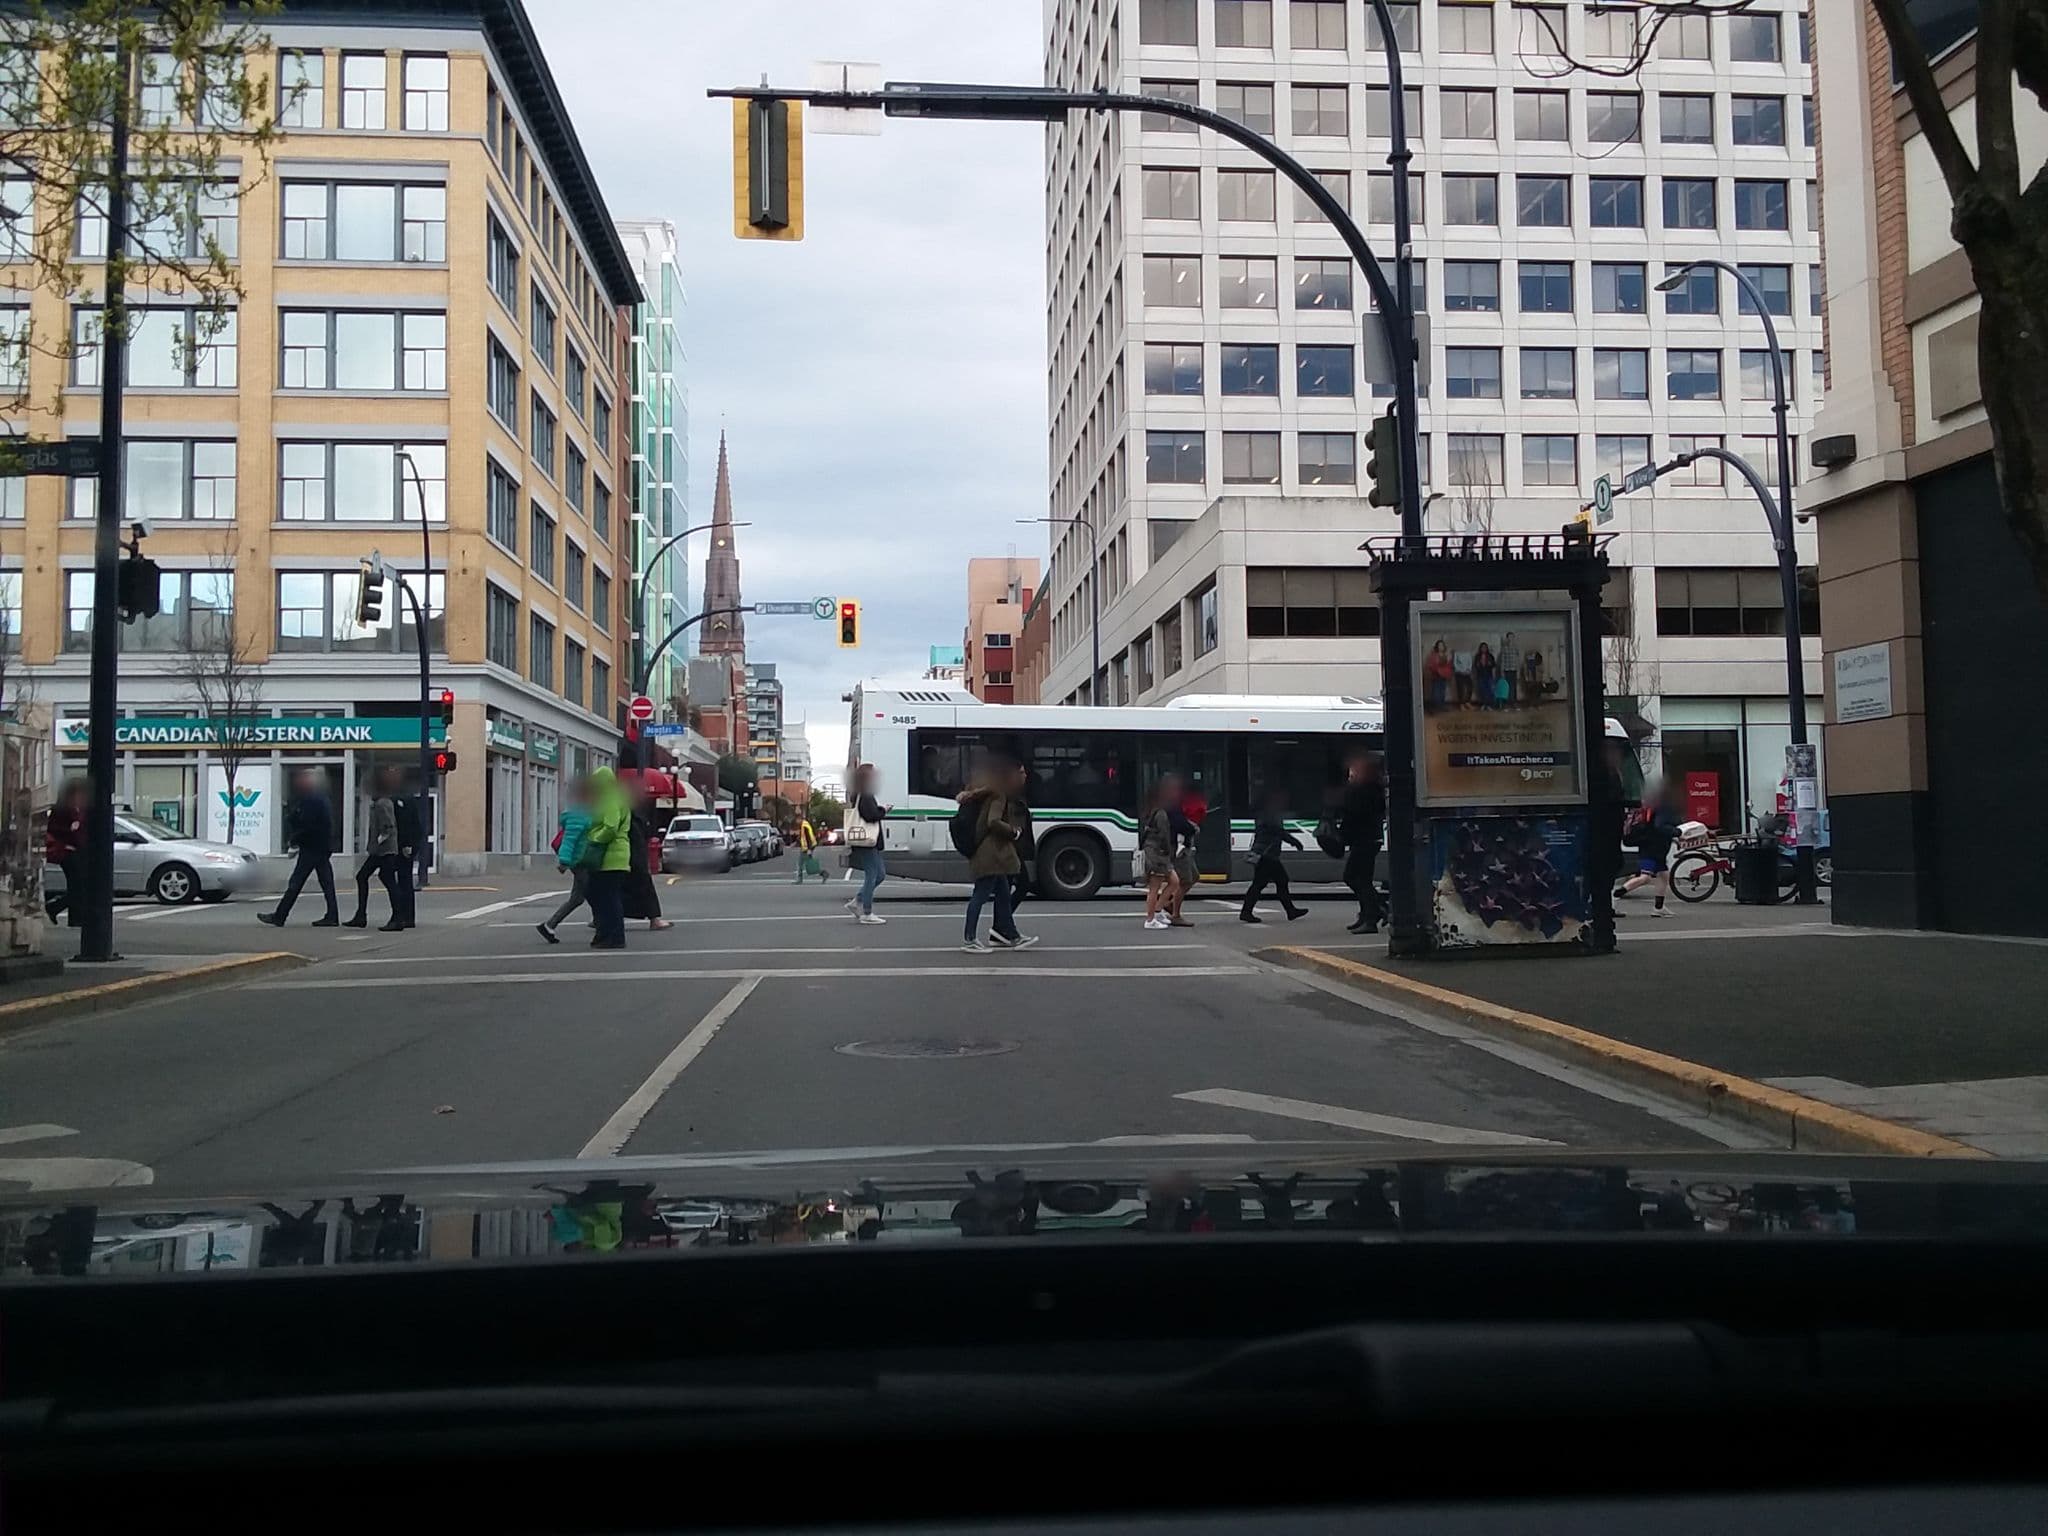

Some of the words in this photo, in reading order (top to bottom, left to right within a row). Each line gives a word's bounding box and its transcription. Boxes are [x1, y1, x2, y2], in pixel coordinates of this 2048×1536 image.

[892, 716, 917, 725] 9485
[646, 726, 673, 734] Douglas
[115, 726, 218, 743] CANADIAN
[224, 726, 314, 742] WESTERN
[320, 726, 373, 741] BANK
[1466, 755, 1554, 765] ItTakesATeacher.ca
[1533, 770, 1553, 778] BCTF
[214, 811, 264, 819] CAADIAN
